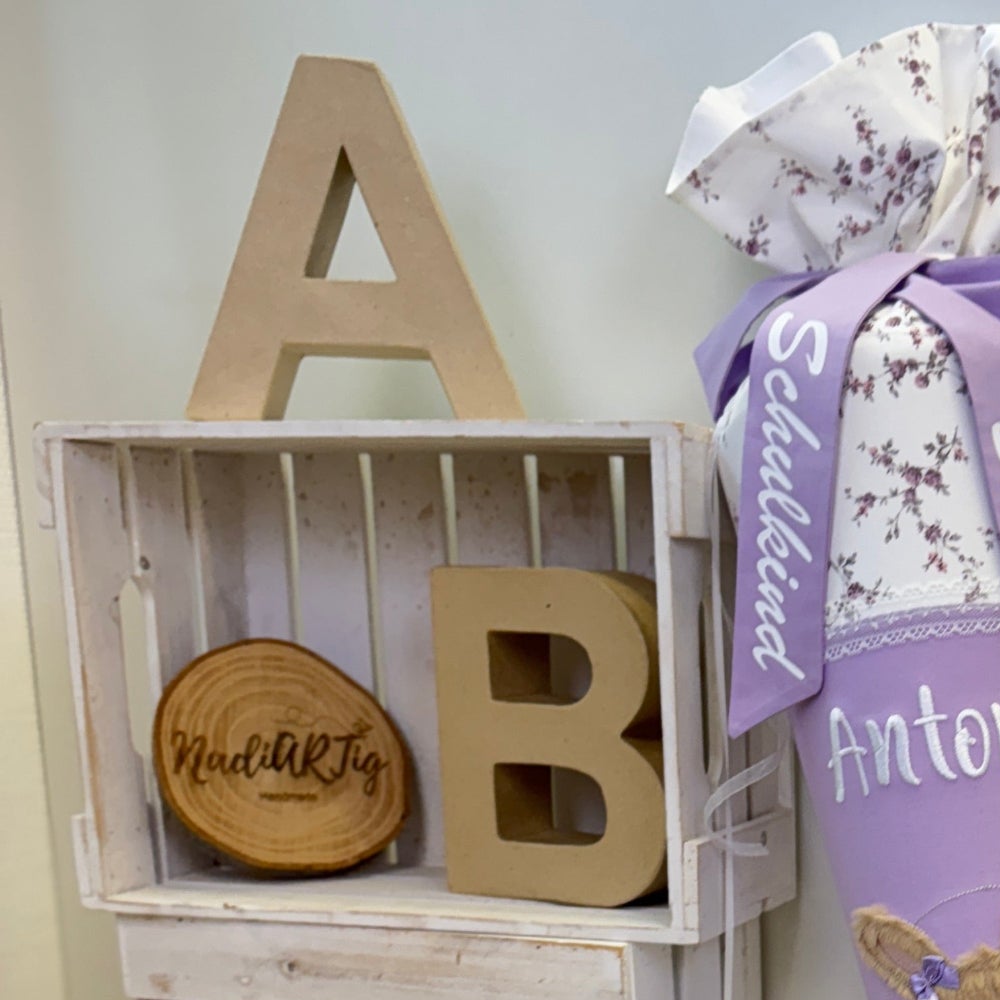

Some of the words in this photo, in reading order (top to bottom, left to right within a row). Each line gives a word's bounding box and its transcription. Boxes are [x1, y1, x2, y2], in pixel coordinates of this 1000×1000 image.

[188, 54, 526, 420] A
[750, 311, 828, 680] Schulkind
[432, 566, 666, 907] B
